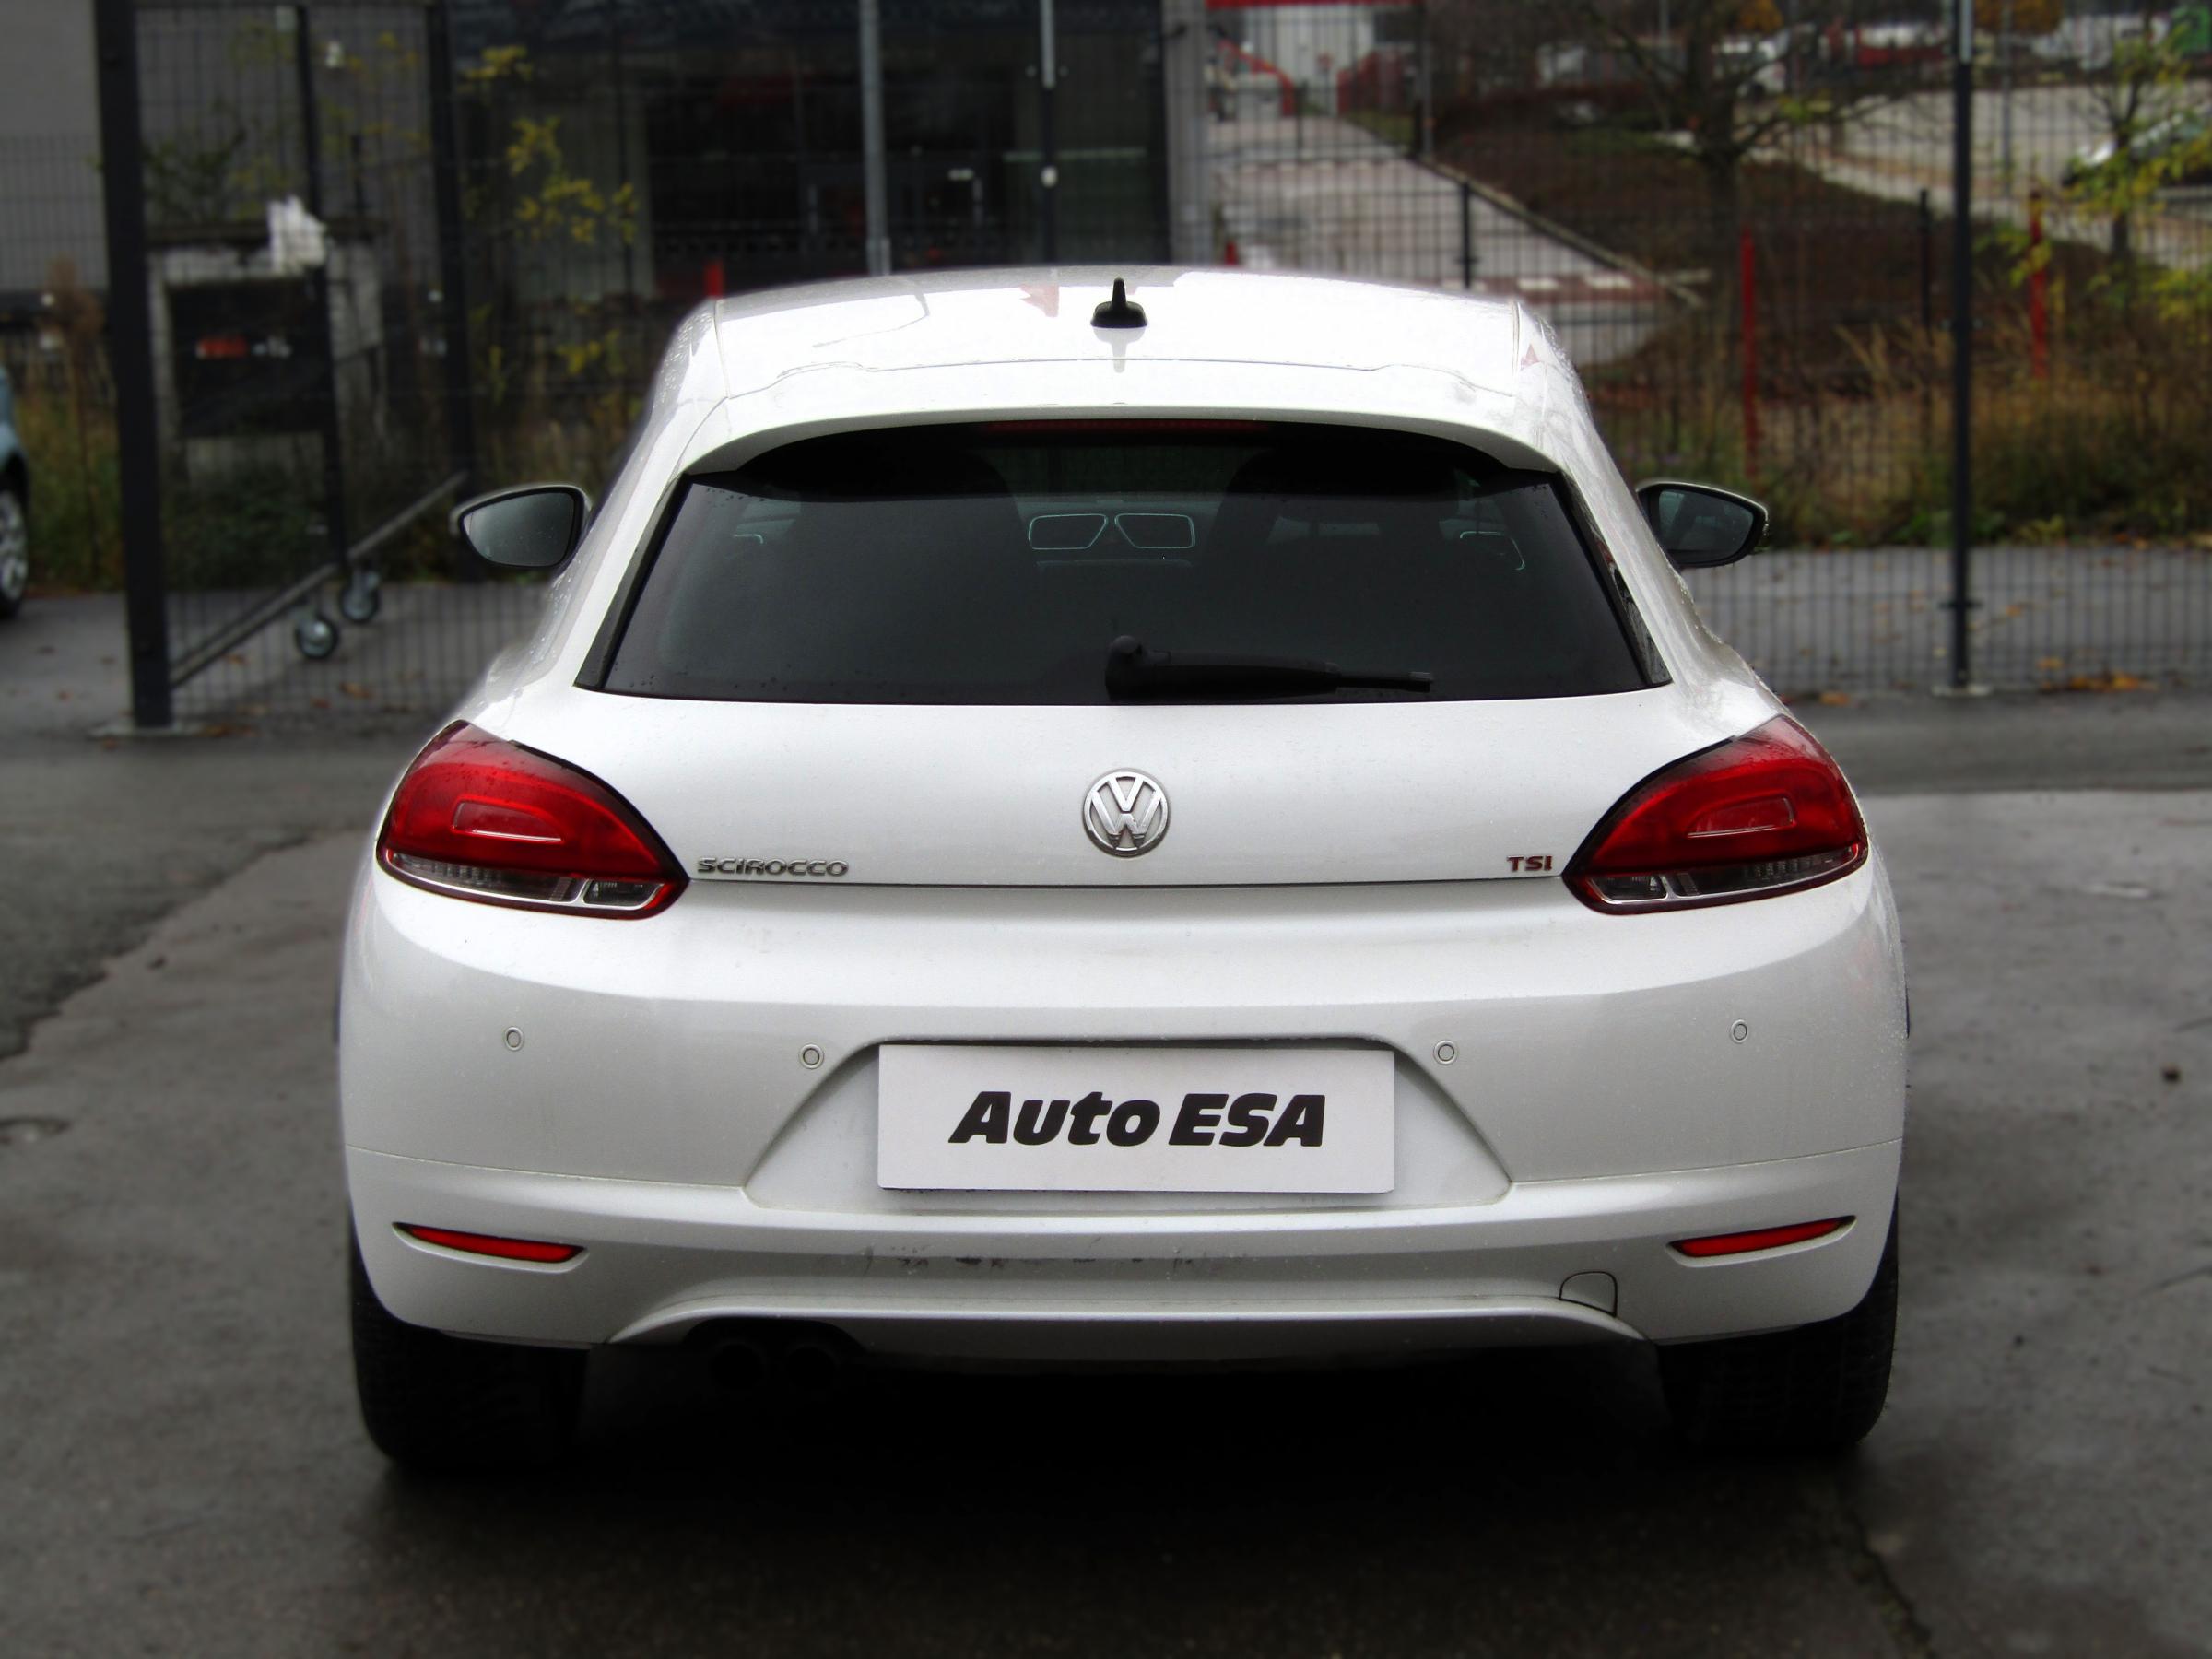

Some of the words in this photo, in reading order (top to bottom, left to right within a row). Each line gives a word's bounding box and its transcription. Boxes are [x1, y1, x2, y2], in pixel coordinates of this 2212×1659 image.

[697, 857, 850, 877] SCIROCCO
[1507, 855, 1553, 872] TSI
[947, 1090, 1161, 1147] Auto
[1168, 1092, 1326, 1147] ESA
